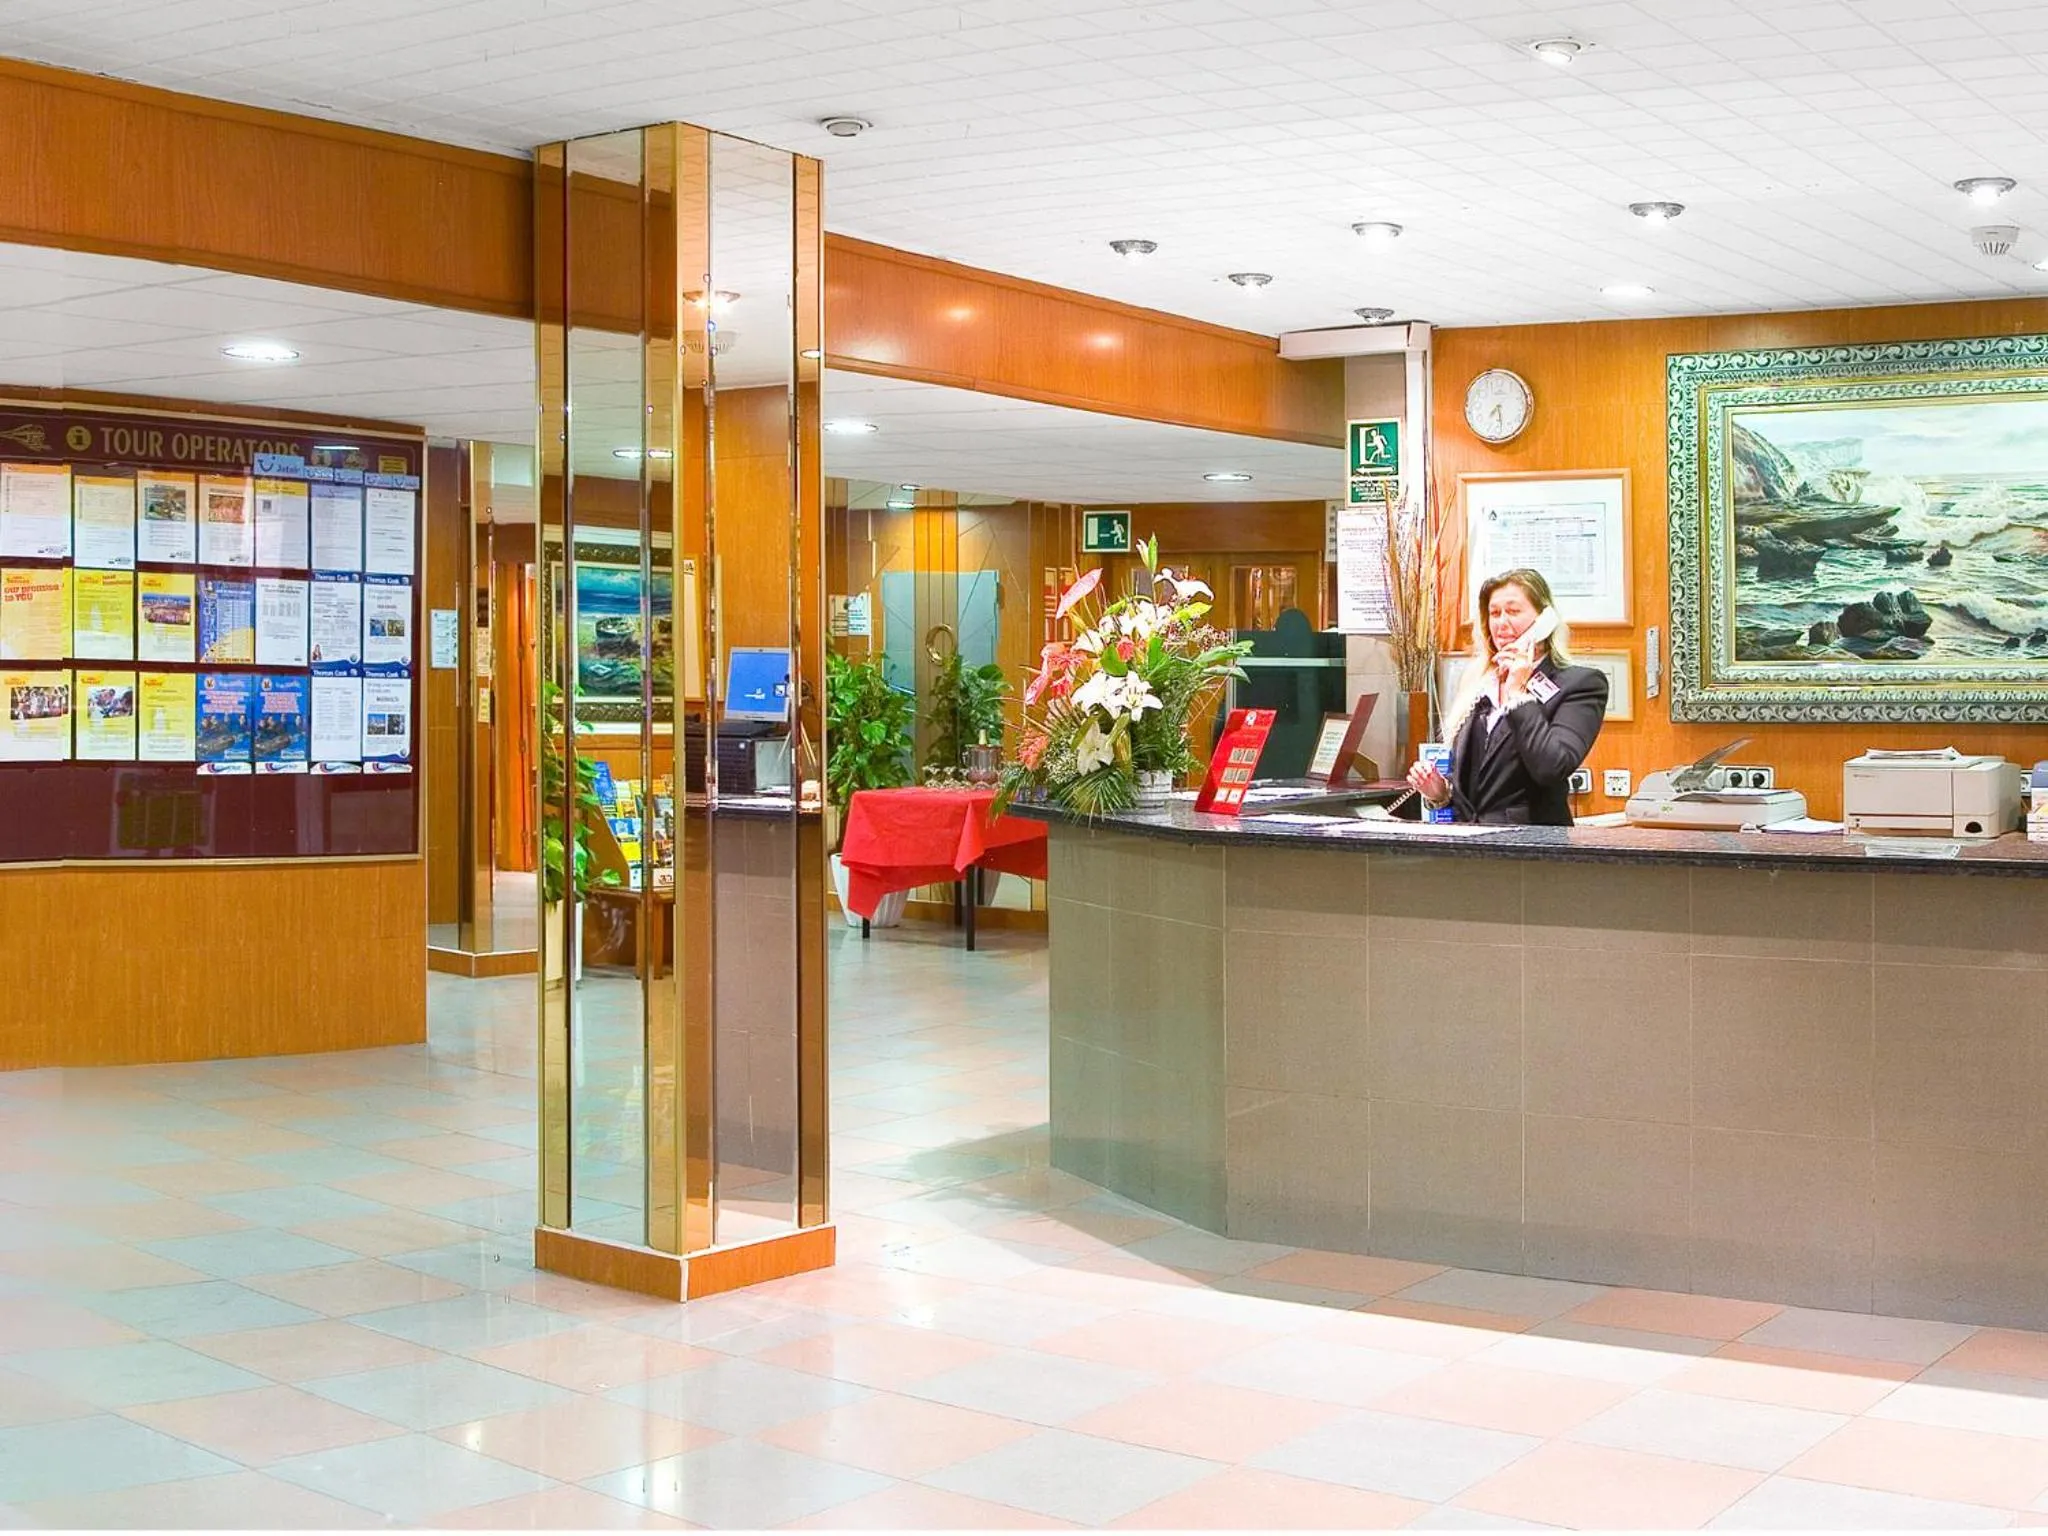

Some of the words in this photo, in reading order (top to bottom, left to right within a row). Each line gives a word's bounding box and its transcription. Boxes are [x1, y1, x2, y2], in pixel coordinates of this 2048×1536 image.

[100, 427, 164, 458] TOUR
[315, 573, 336, 581] Thomas
[367, 576, 387, 584] Thomas
